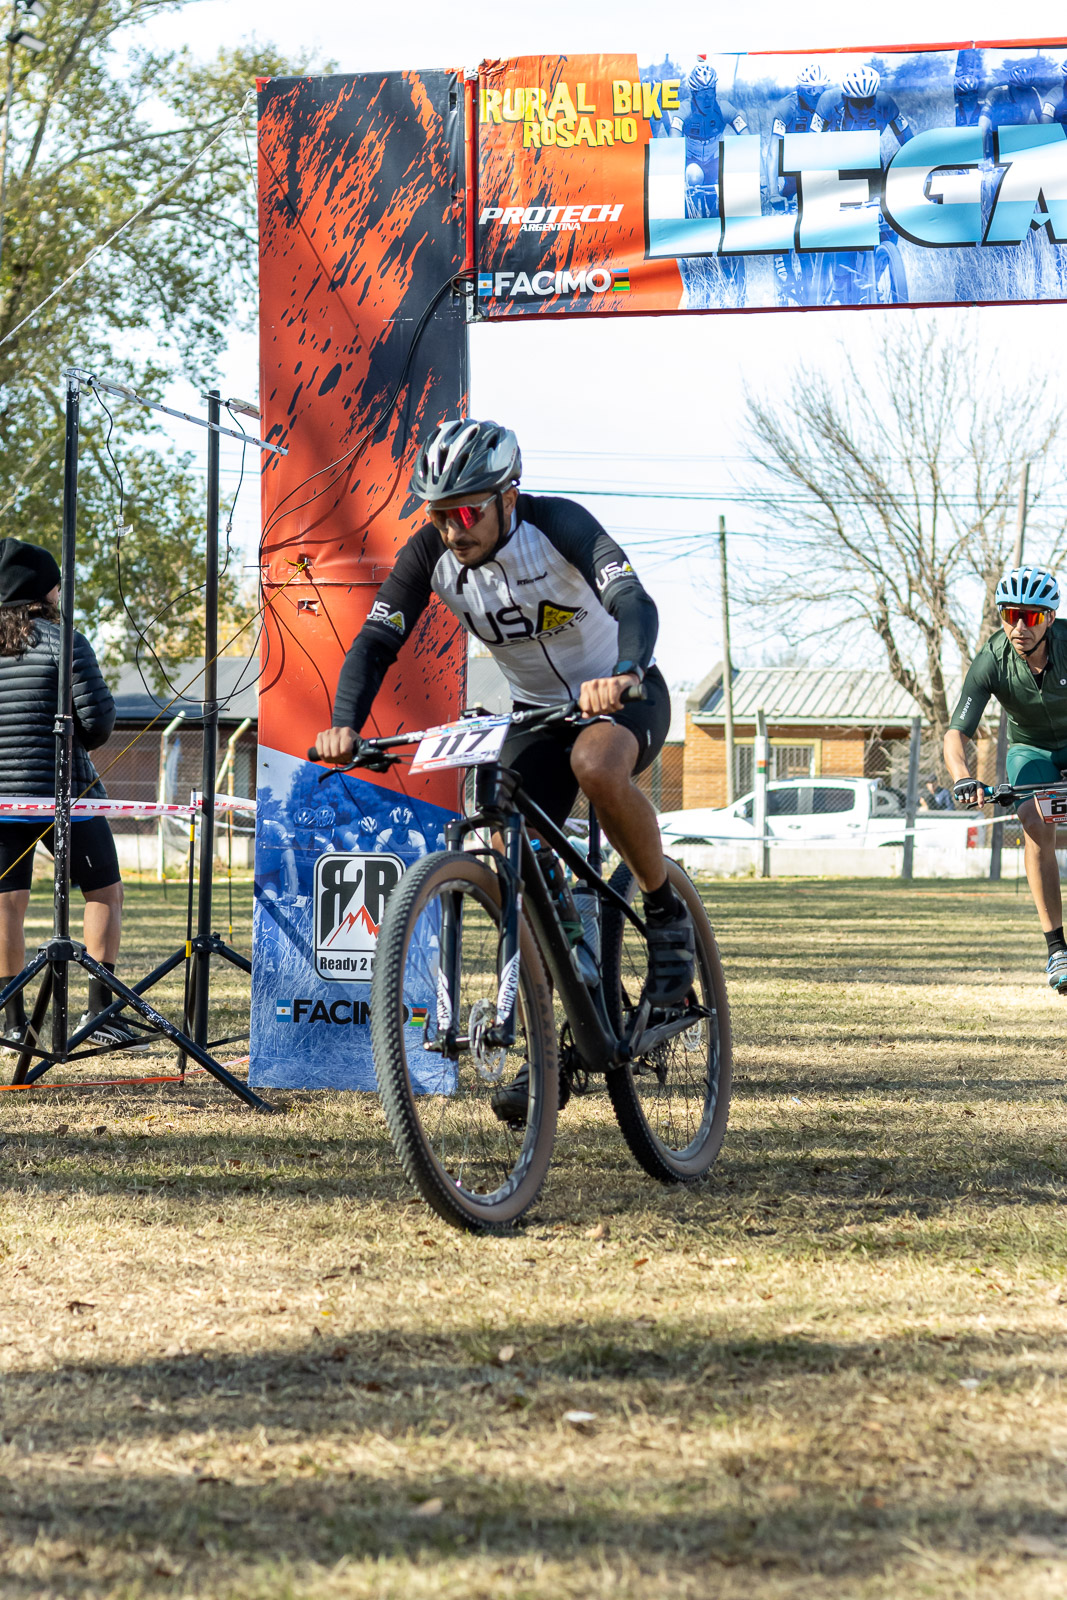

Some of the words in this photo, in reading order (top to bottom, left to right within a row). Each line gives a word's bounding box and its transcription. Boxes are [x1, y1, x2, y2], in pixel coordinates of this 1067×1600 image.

[480, 82, 596, 123] RURAL
[612, 79, 681, 120] BIKE
[523, 117, 638, 148] ROSARIO
[478, 204, 624, 225] PROTECH
[518, 222, 582, 232] ARGENTINA
[494, 268, 612, 296] FACIMO
[463, 599, 583, 645] USA
[431, 728, 495, 759] 117
[320, 956, 358, 972] Ready
[360, 957, 368, 971] 2
